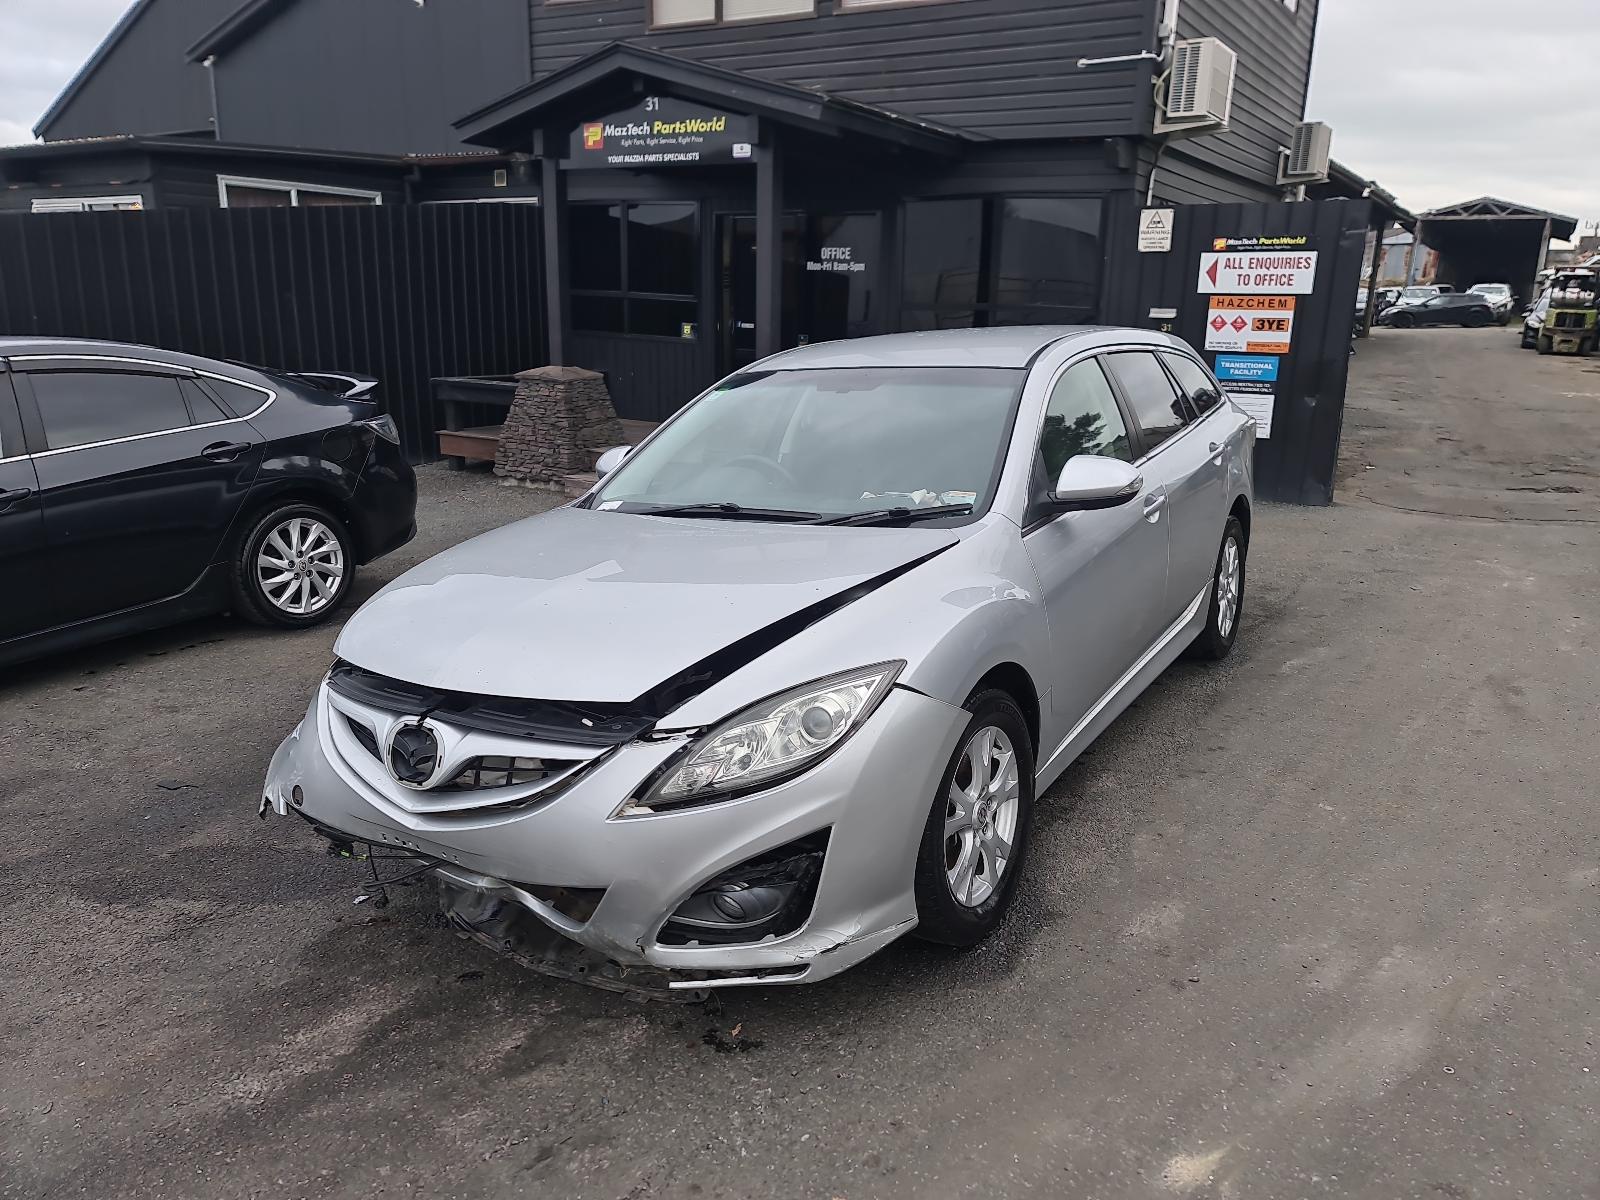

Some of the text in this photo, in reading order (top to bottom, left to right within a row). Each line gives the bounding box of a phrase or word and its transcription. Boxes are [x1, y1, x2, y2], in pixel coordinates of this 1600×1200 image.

[645, 97, 659, 111] 31
[604, 116, 726, 137] MazTech PartsWorld
[608, 152, 699, 163] YOUR MAZDA PARTS SPECIALISTS
[1258, 236, 1307, 245] PartsWorld
[821, 247, 851, 260] OFFICE
[807, 261, 865, 272] Mon-Fri 8am-5pm
[1224, 256, 1312, 271] ALL ENQUIRIES
[1237, 273, 1295, 287] TO OFFICE
[1216, 298, 1287, 308] HAZCHEM
[1255, 319, 1286, 330] 3YE
[1221, 361, 1273, 370] TRANSITIONAL
